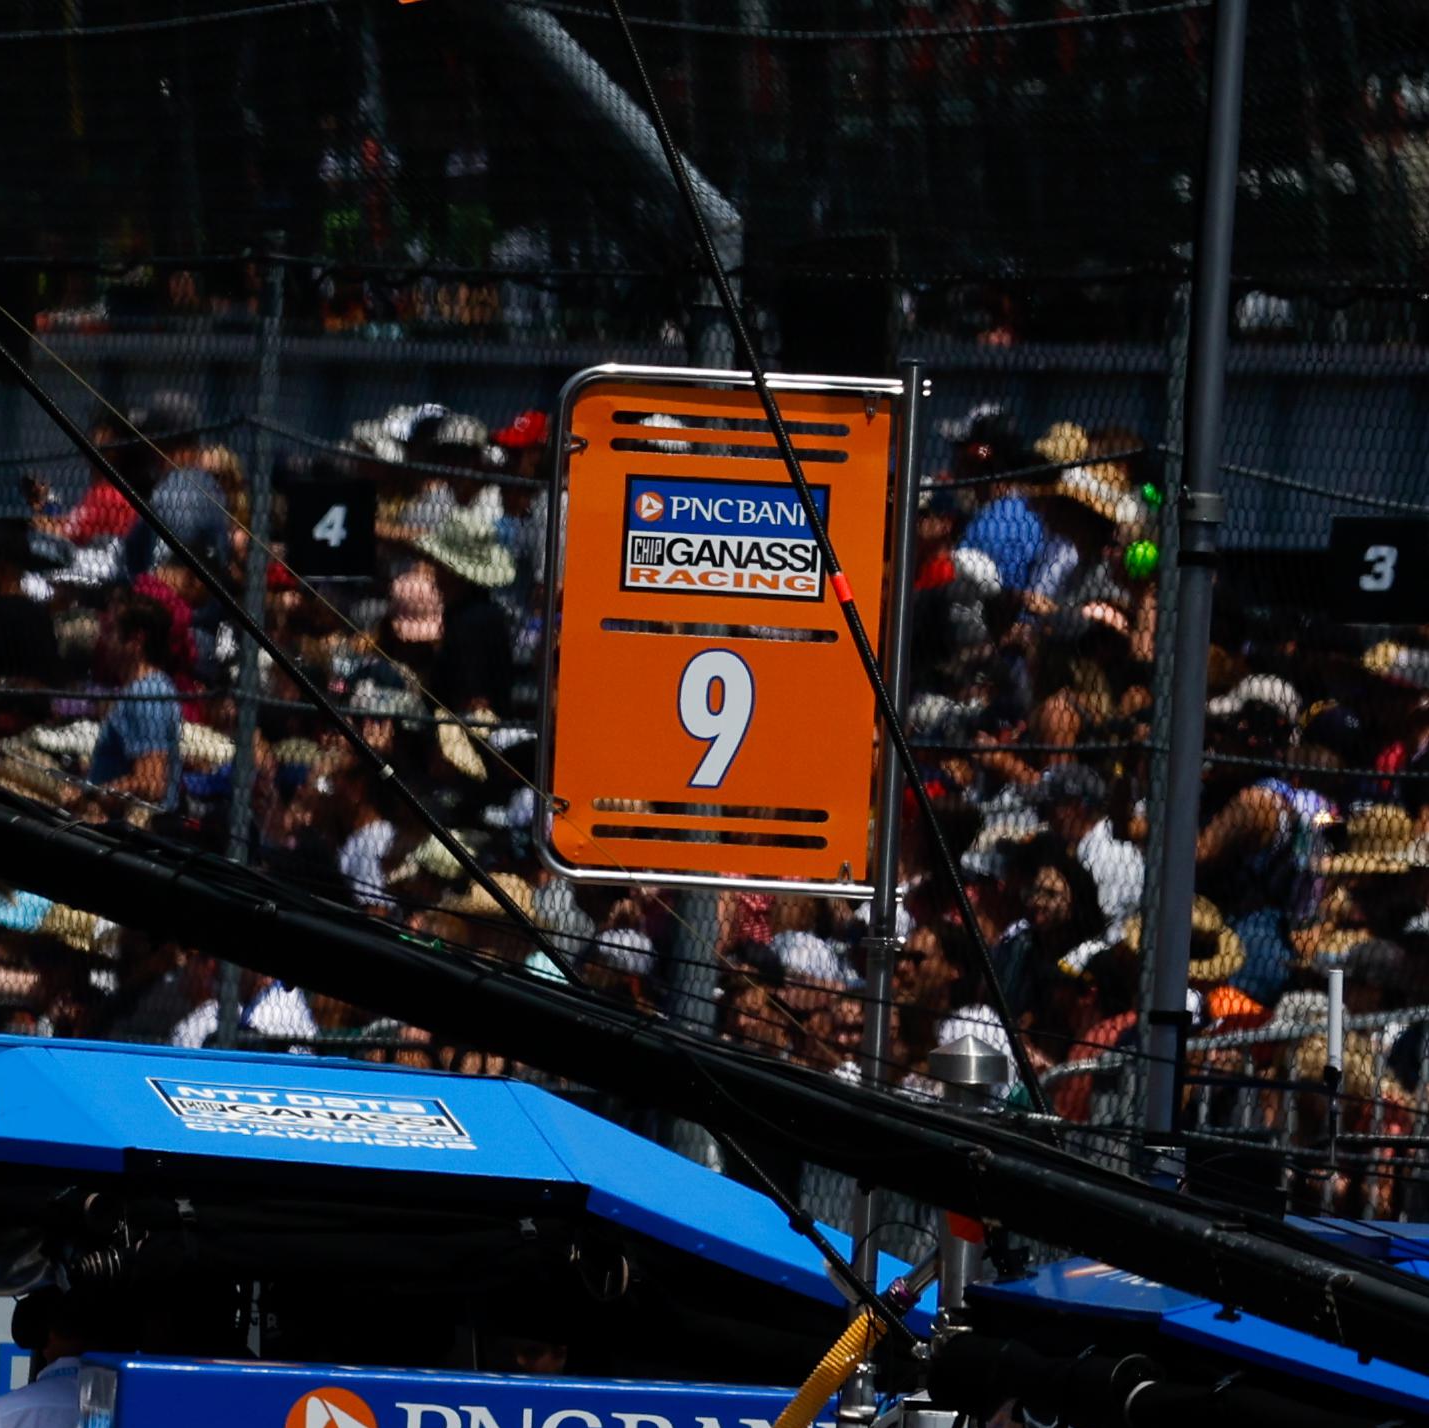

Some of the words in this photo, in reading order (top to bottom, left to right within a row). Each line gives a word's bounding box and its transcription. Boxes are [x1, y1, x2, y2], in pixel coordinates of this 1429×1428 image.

[312, 505, 347, 549] 4
[632, 537, 664, 566] CHIP
[665, 538, 819, 575] GANASSI
[1359, 545, 1398, 592] 3
[629, 568, 817, 593] RACING
[677, 649, 754, 788] 9
[177, 1086, 278, 1103] NTT
[225, 1102, 446, 1128] GANASSI
[185, 1122, 478, 1151] CHAMPIONS
